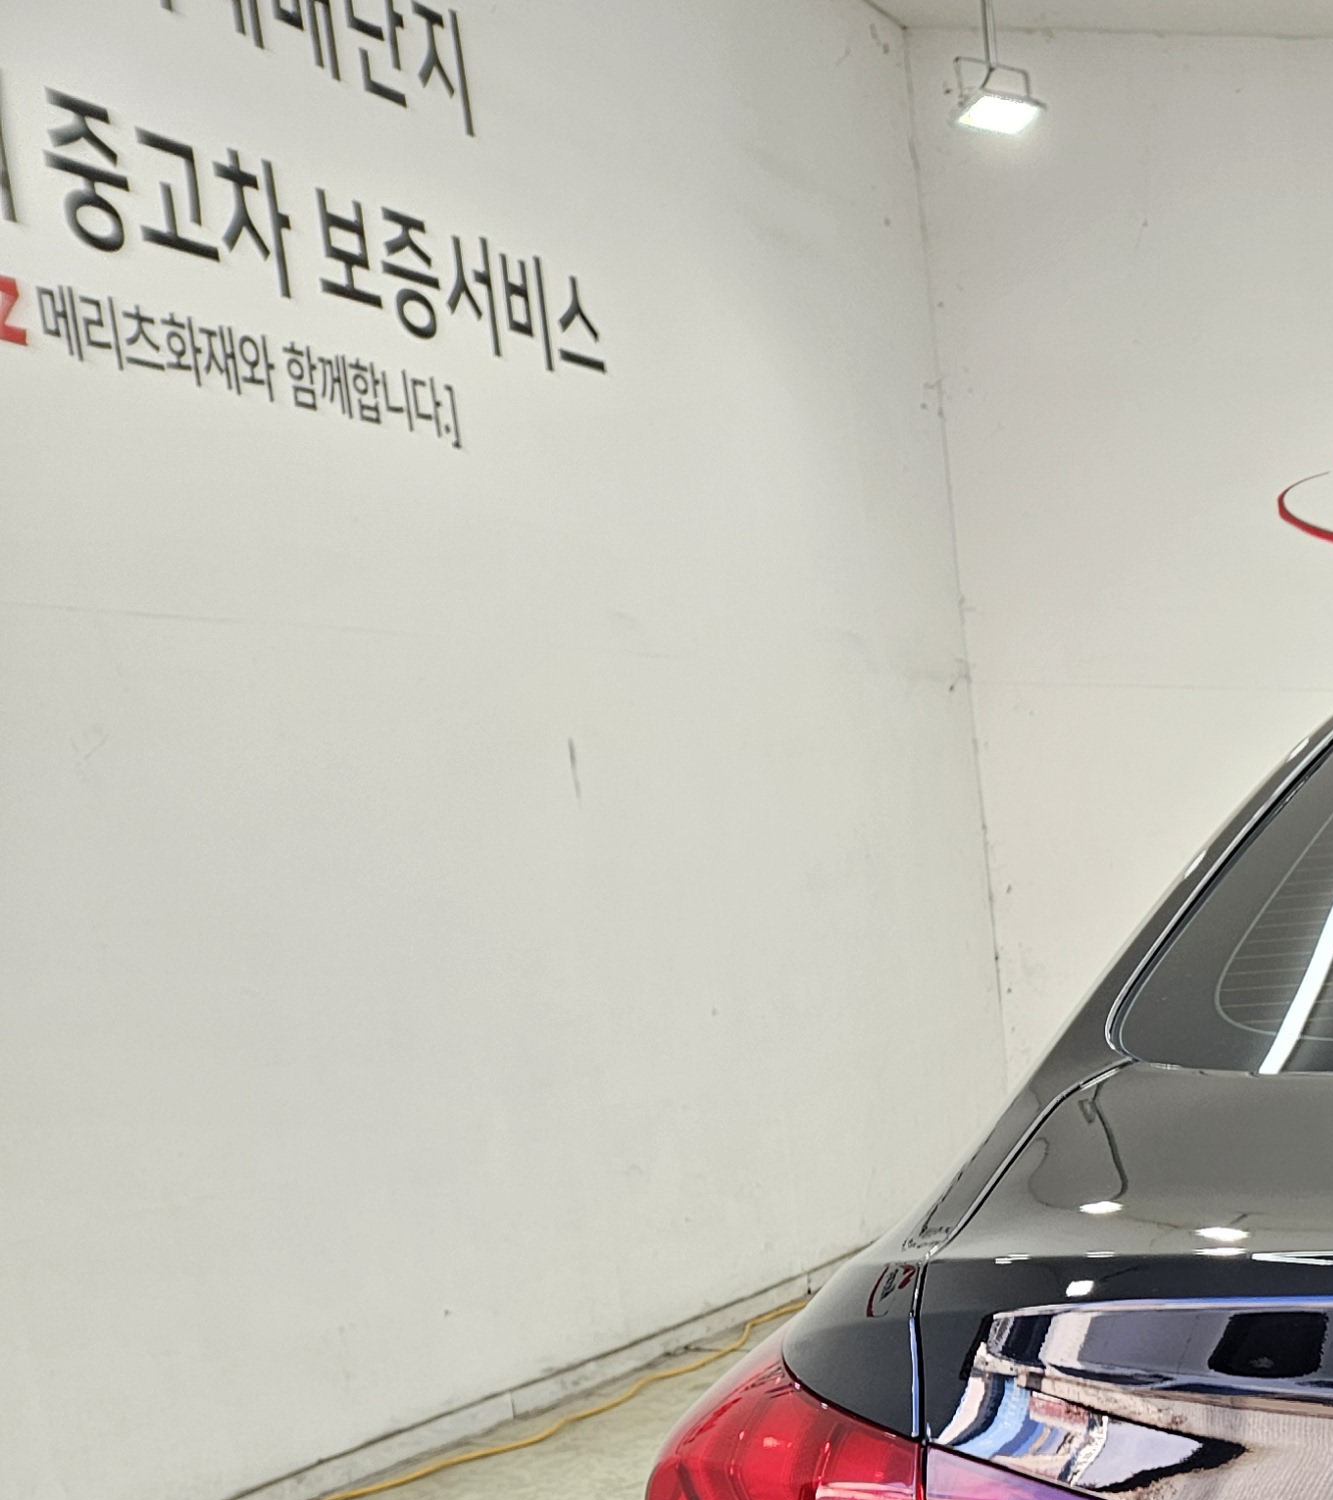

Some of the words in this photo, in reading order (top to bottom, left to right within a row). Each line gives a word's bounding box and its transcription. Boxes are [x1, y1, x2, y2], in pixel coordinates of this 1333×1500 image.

[42, 86, 292, 299] 중고차
[315, 187, 608, 374] 보증서비스
[35, 283, 276, 404] 메리츠화재와
